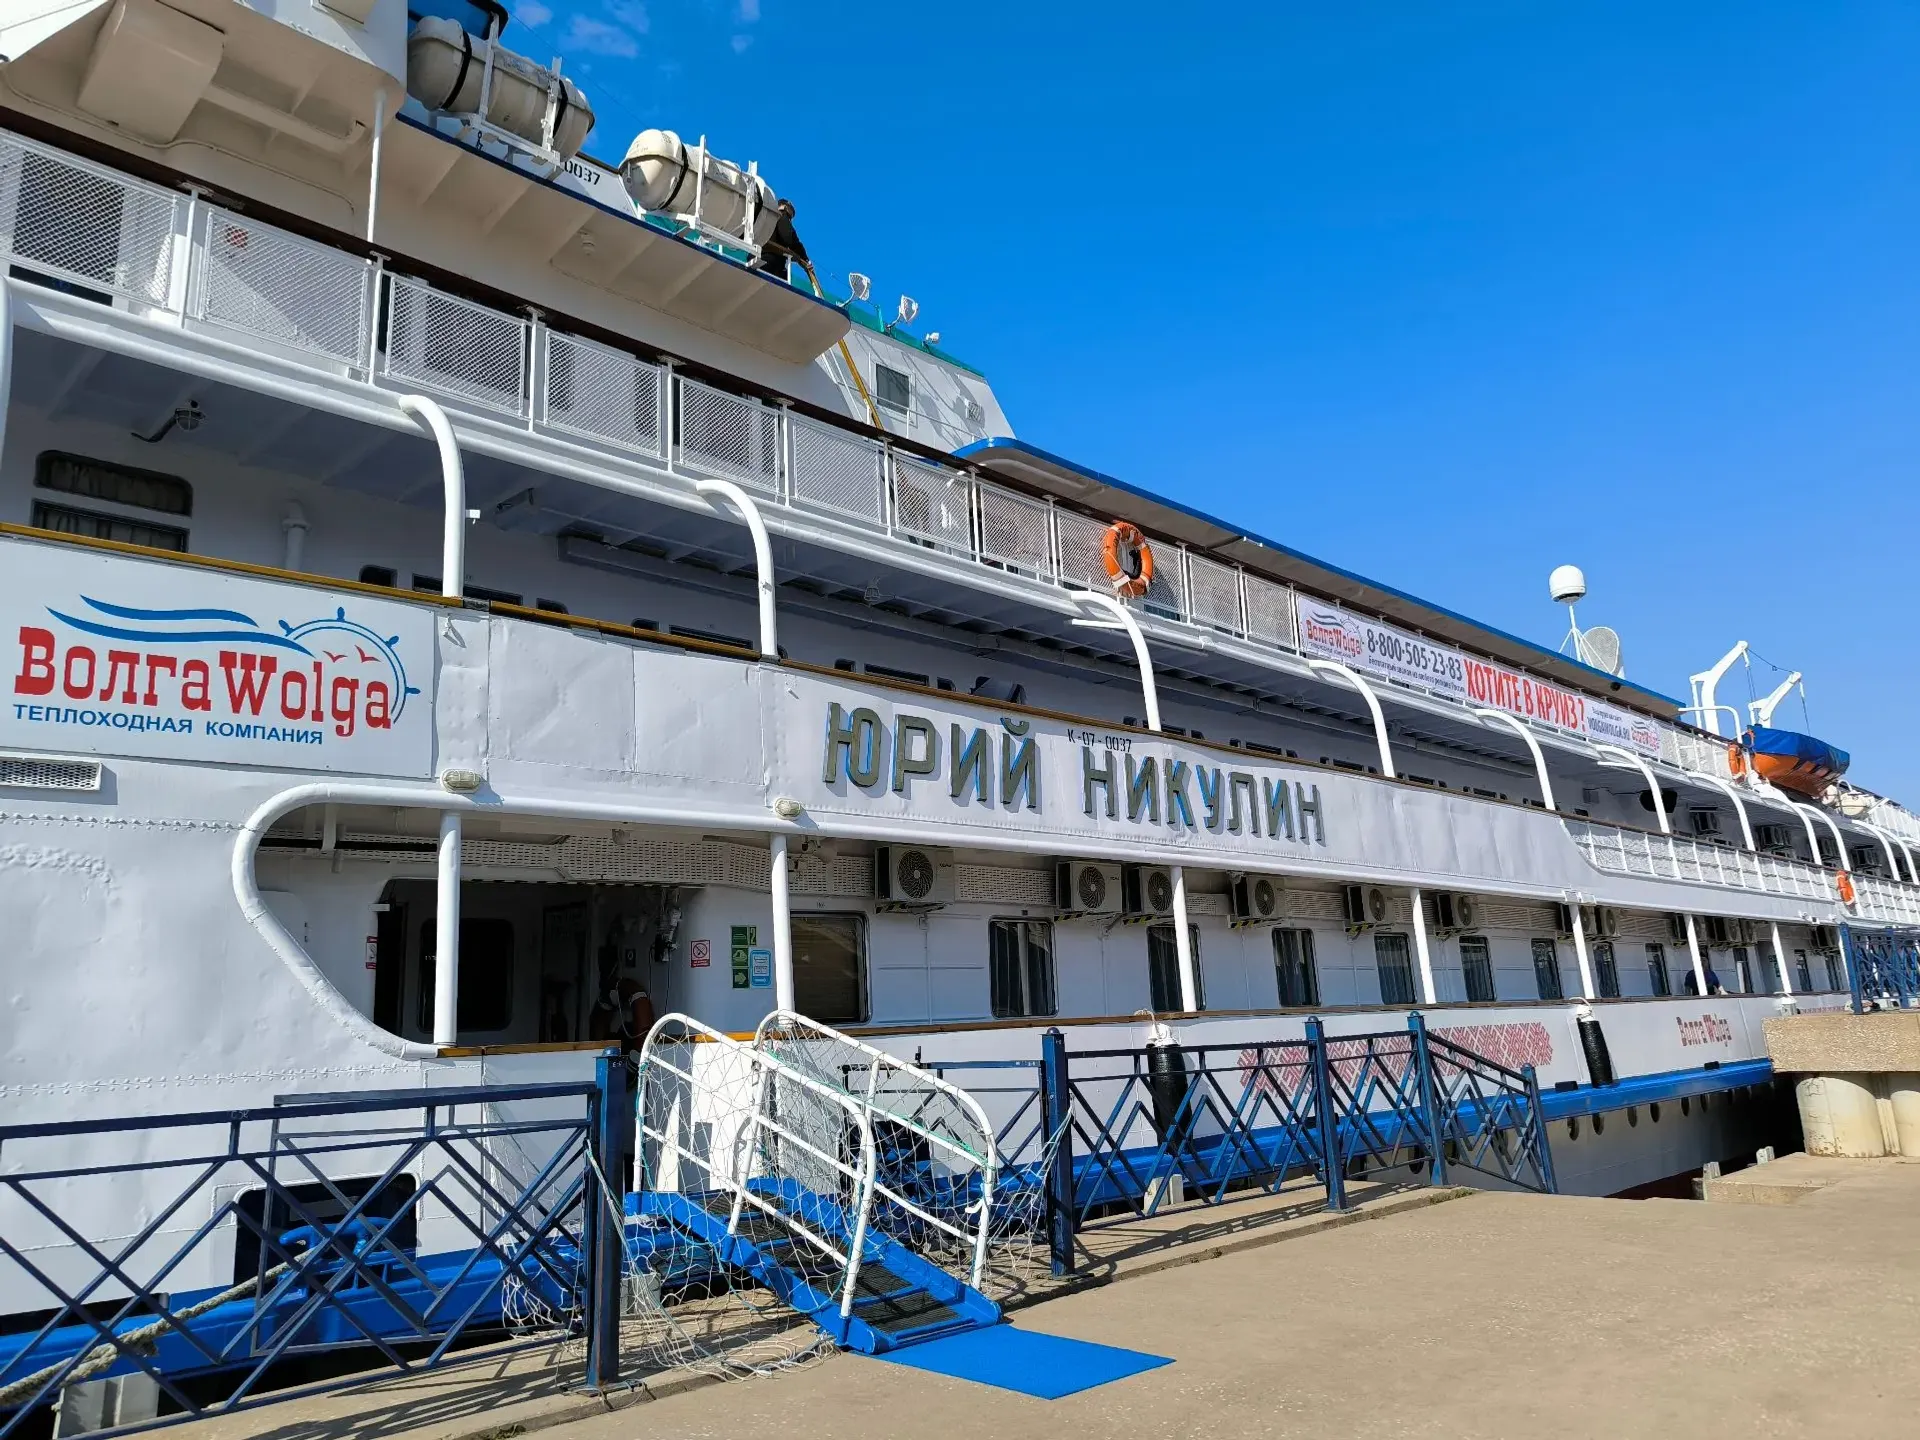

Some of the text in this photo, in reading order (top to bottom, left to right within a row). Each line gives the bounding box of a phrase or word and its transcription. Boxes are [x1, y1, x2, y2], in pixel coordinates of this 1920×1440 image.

[14, 626, 392, 738] ВолгаWolga
[1463, 659, 1522, 713] ХОТИТЕ
[1522, 679, 1534, 716] В
[13, 704, 324, 745] ТЕПЛОХОДНАЯ КОМПАНИЯ
[824, 701, 1324, 842] ЮРИЙ НИКУЛИН
